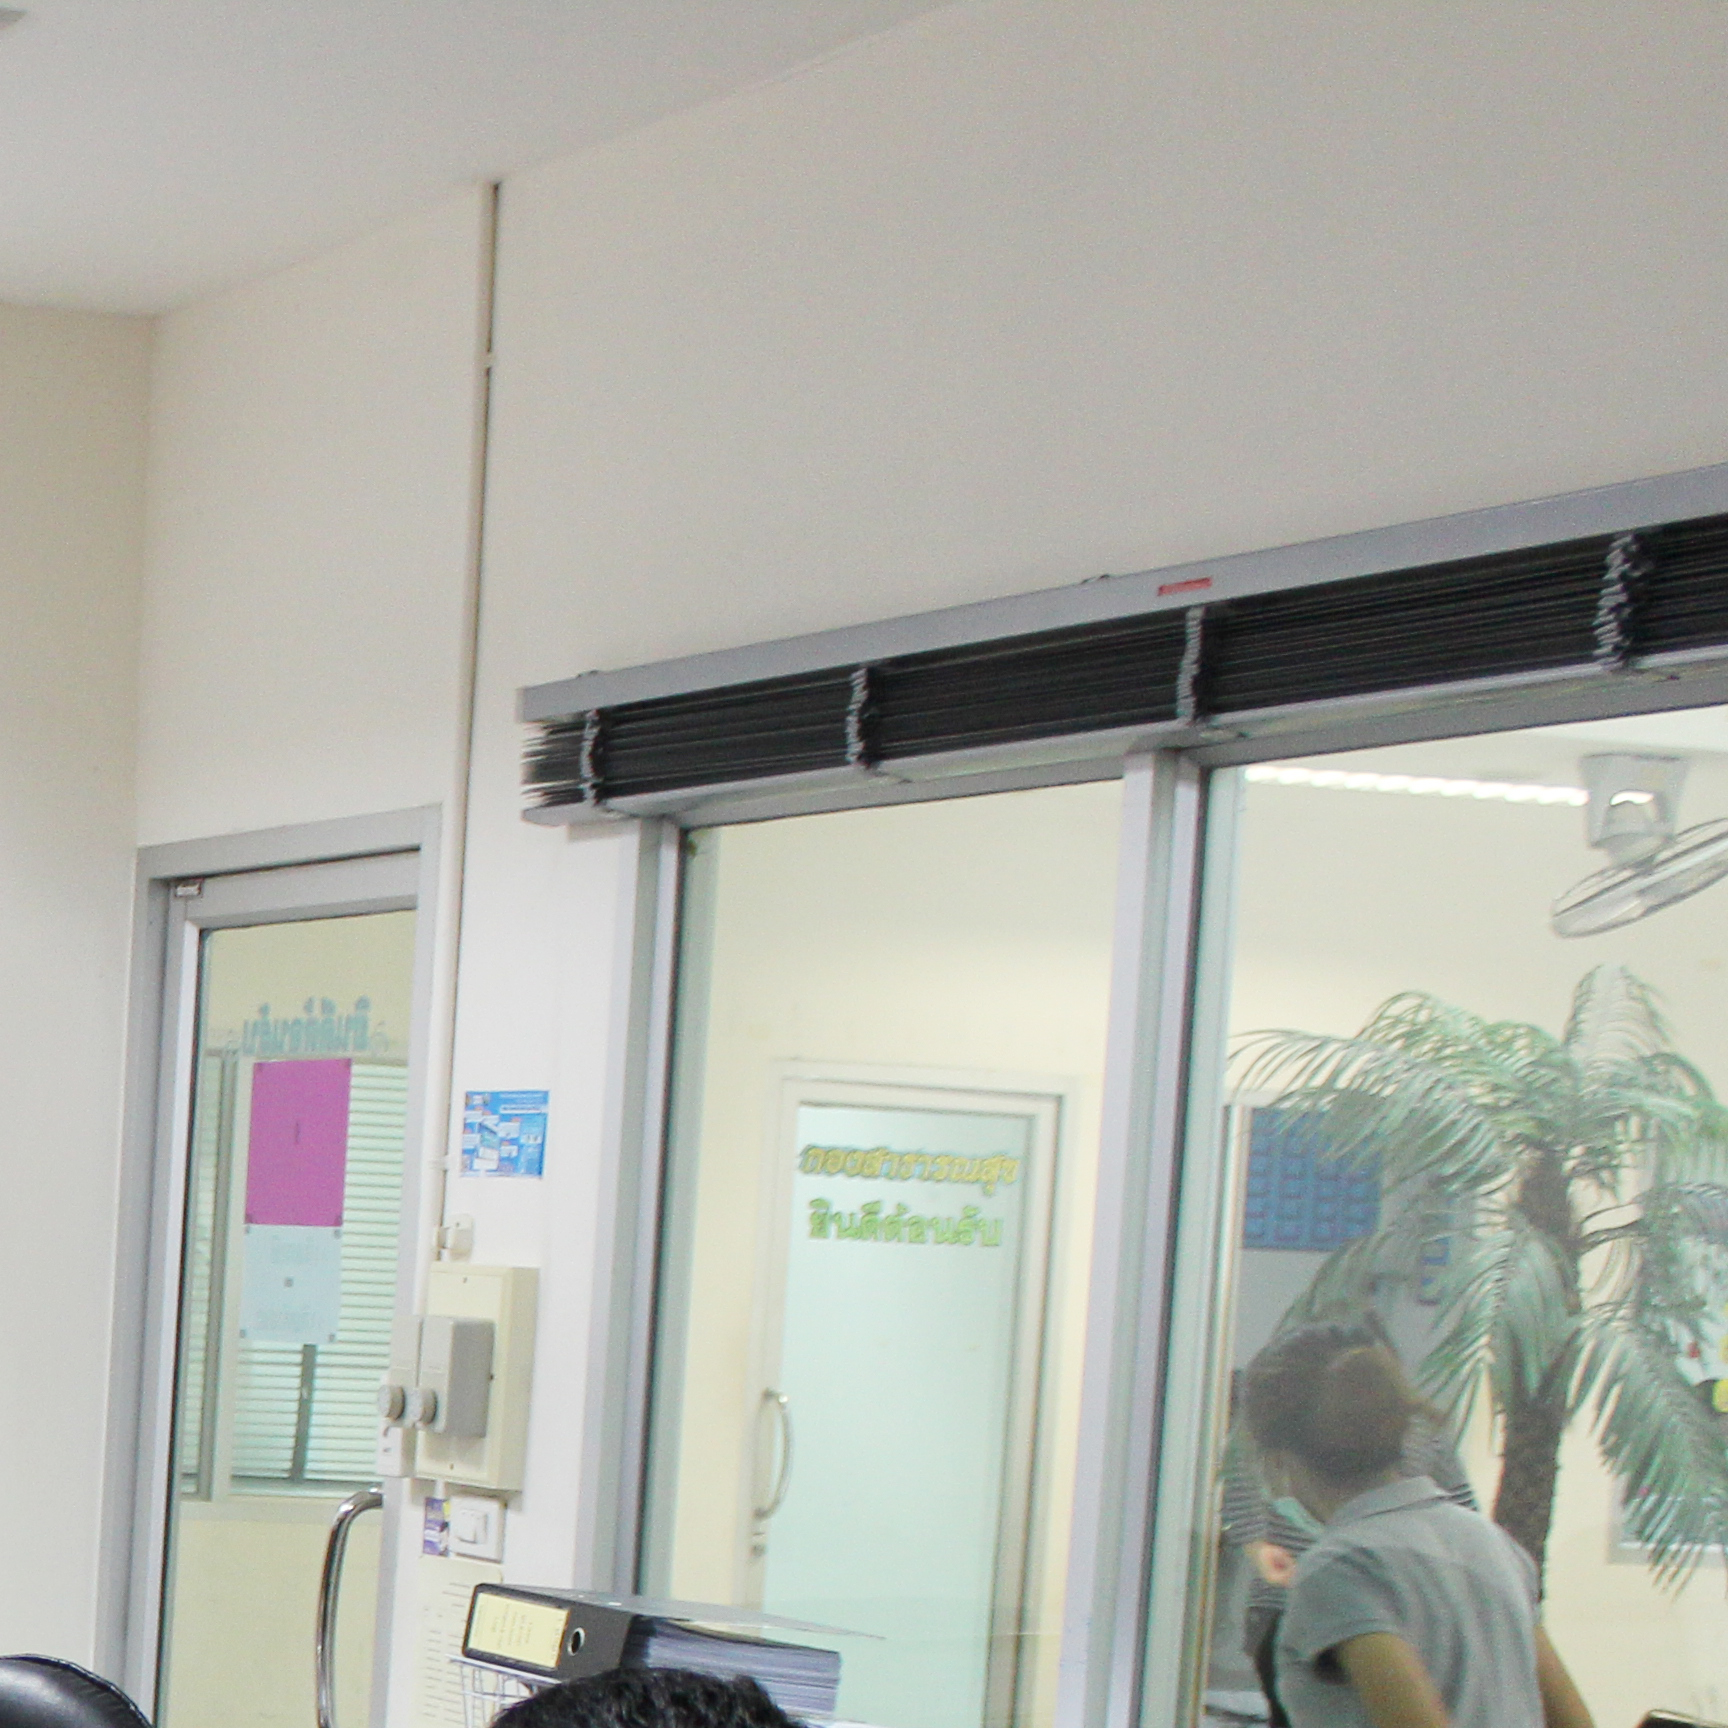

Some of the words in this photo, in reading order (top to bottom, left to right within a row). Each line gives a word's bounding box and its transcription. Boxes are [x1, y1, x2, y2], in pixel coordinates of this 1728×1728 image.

[798, 1144, 1021, 1196] กองสาธารณสุข
[809, 1198, 1003, 1248] ยินดีต้อนรับ
